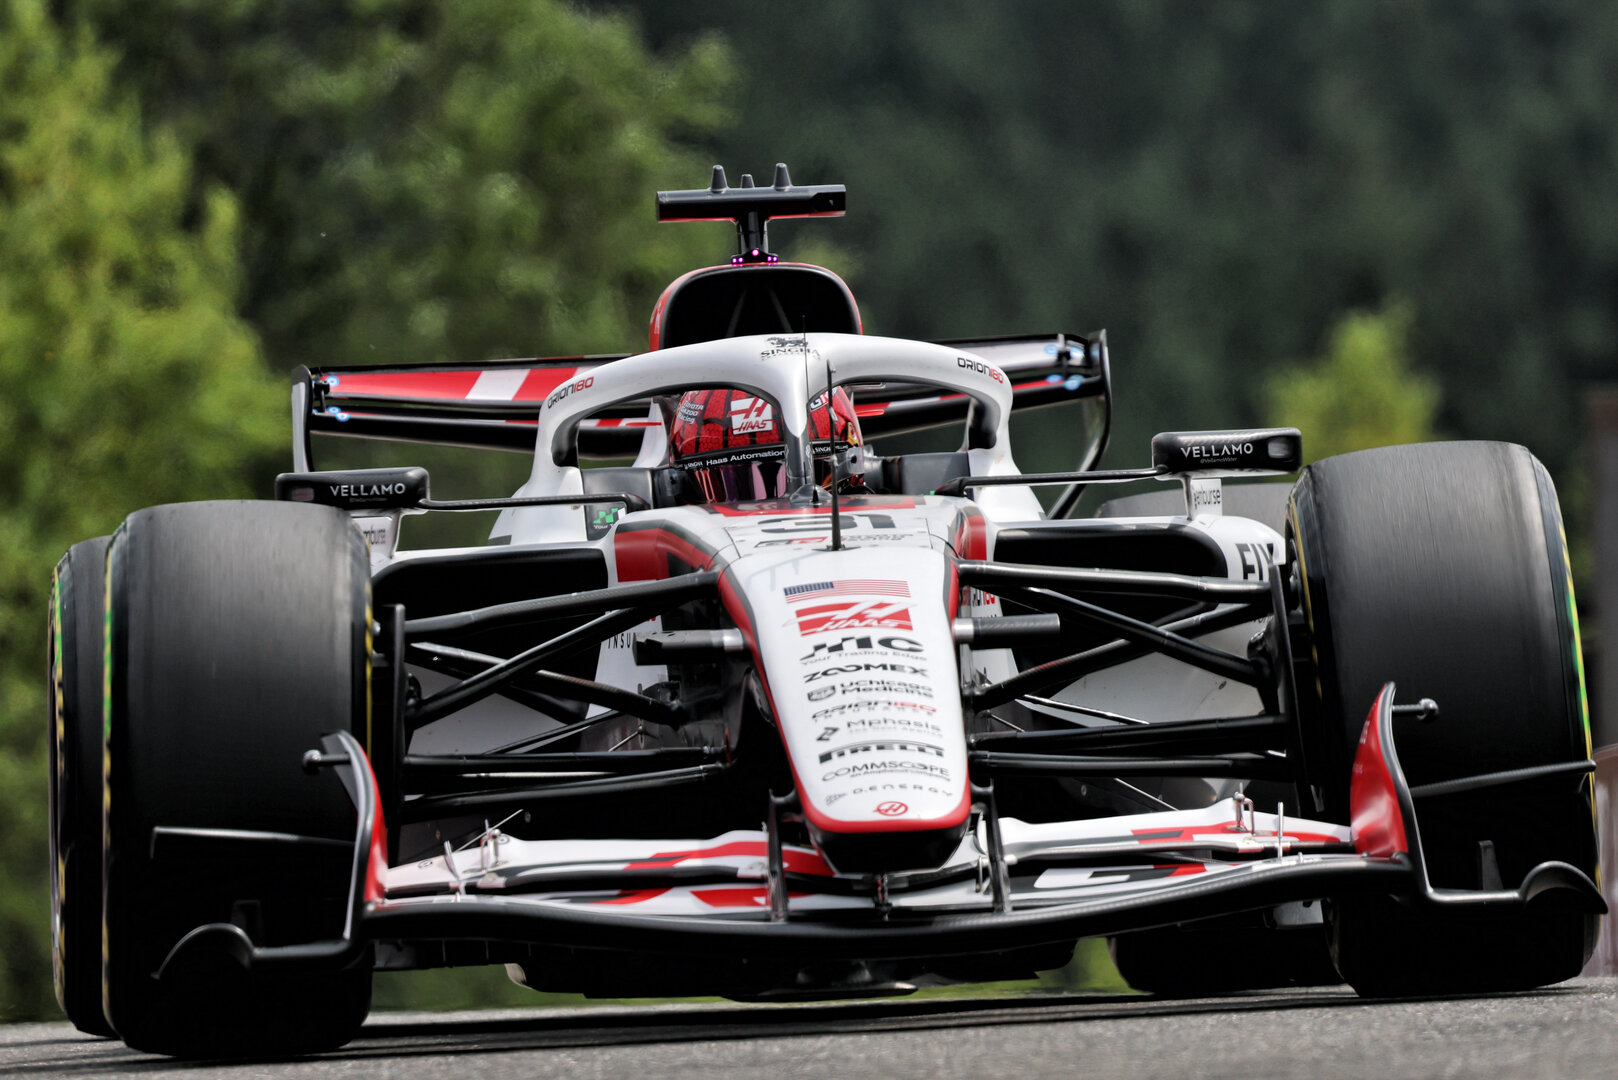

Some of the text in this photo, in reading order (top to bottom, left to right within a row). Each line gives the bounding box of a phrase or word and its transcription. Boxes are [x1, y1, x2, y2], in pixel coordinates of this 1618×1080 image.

[736, 422, 768, 433] HAAS
[705, 455, 729, 466] Haas
[730, 449, 785, 462] Automation
[1181, 443, 1254, 458] VELLAMO
[330, 483, 406, 497] VELLAMO
[800, 655, 831, 665] Your
[892, 651, 928, 661] Edge
[803, 663, 929, 683] ZOOMEX
[841, 685, 934, 698] Medicine
[847, 717, 942, 732] Mphasis
[818, 740, 944, 765] PIRELLI
[822, 760, 951, 782] COMMSCOPE
